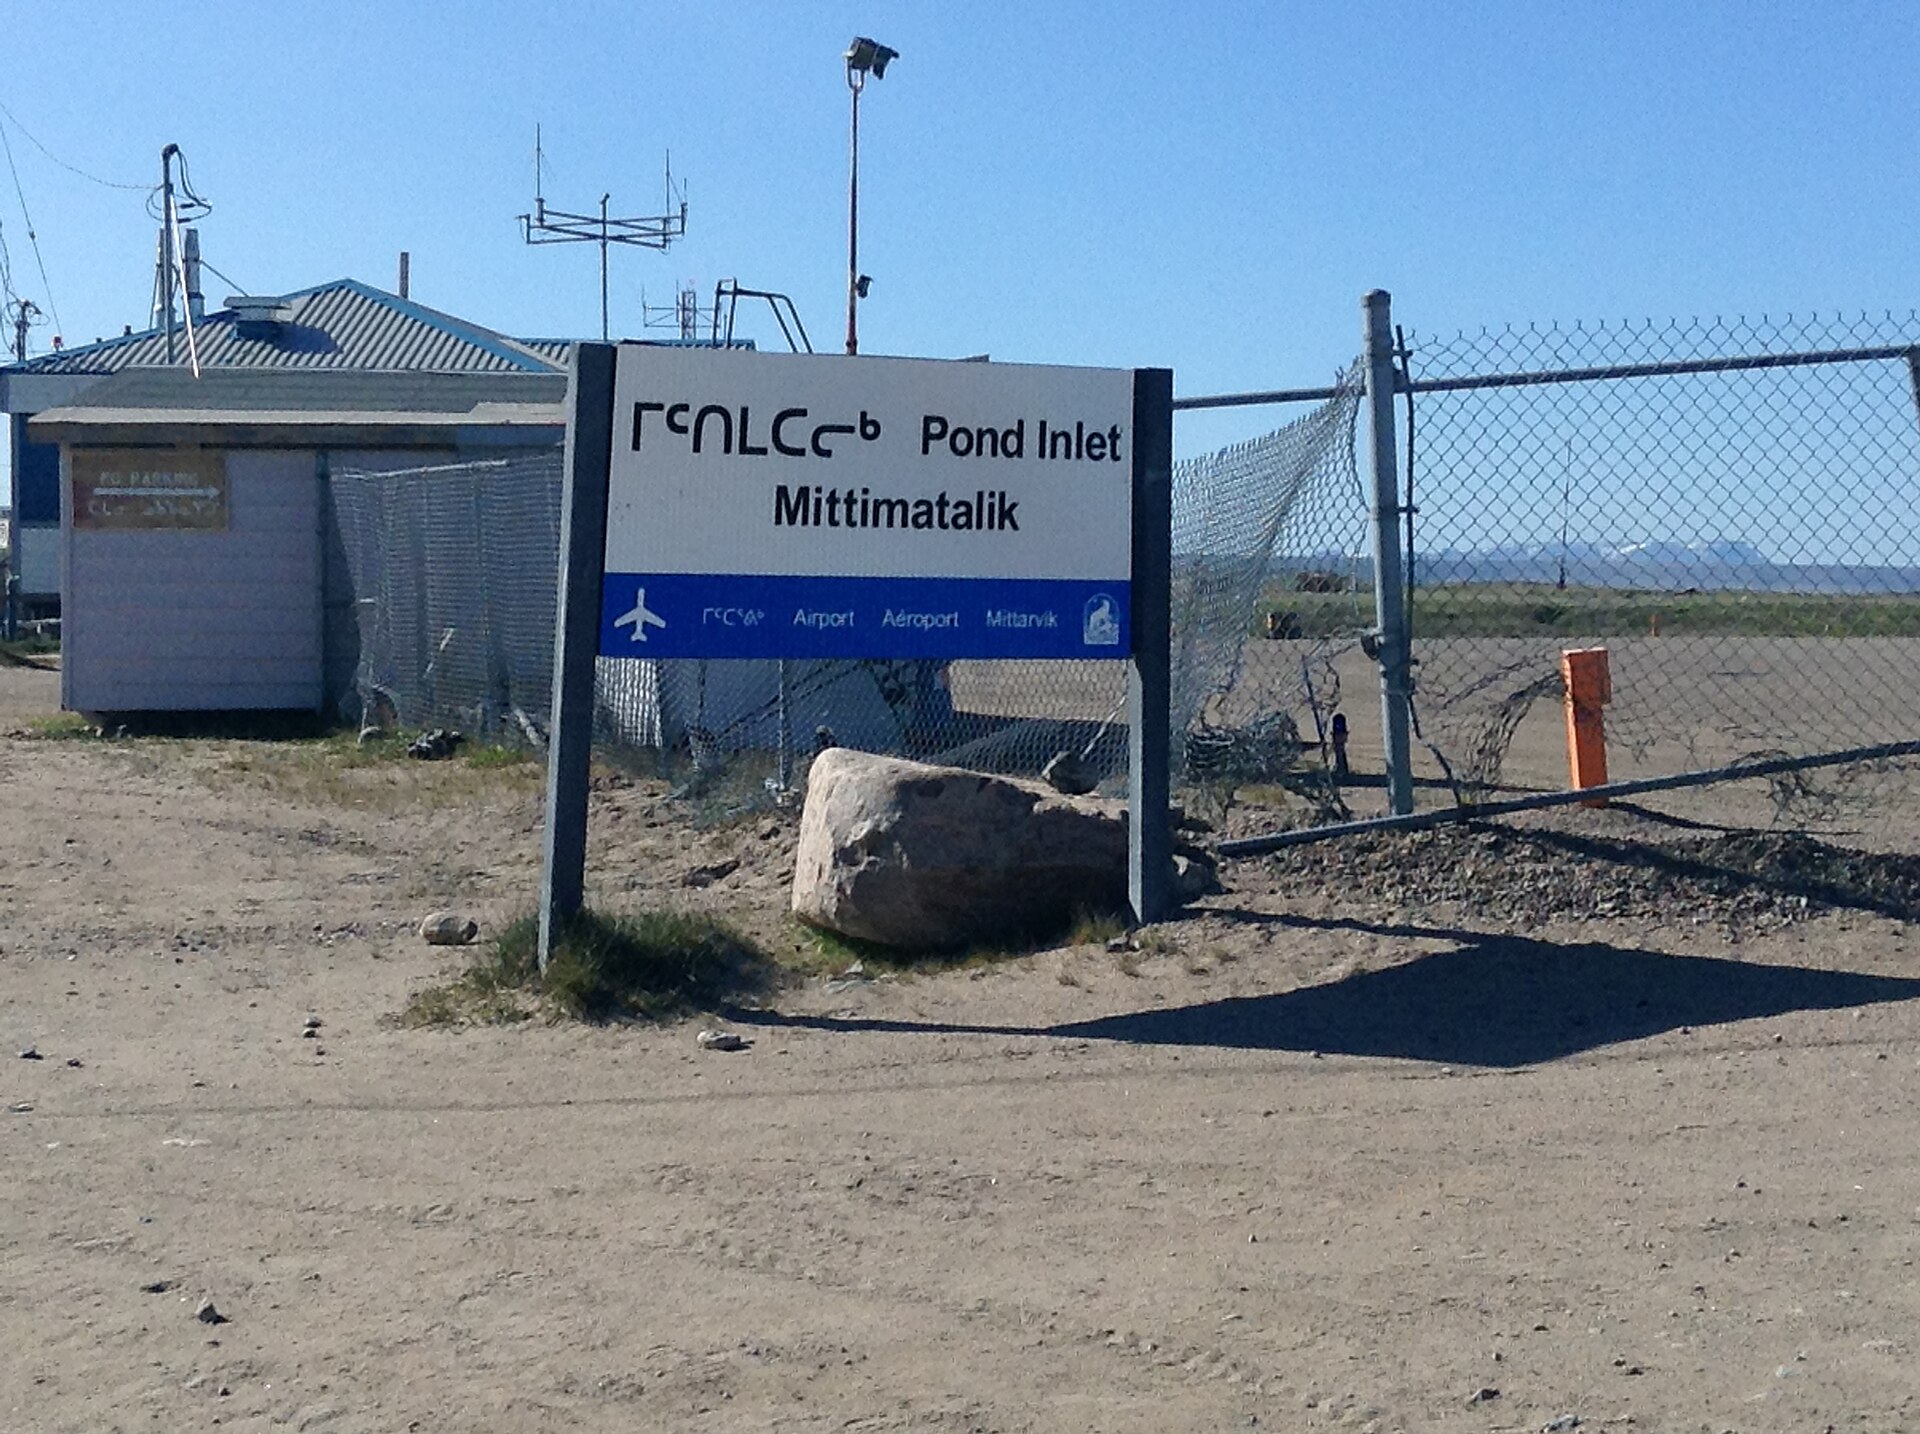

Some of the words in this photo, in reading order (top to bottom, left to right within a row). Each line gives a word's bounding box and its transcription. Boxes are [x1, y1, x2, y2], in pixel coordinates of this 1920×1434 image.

[921, 413, 1025, 460] Pond
[1036, 418, 1122, 463] Inlet
[774, 484, 1020, 532] Mittimatalik
[793, 608, 855, 630] Airport
[882, 608, 960, 631] Aéroport
[985, 609, 1058, 628] Mittarvik
